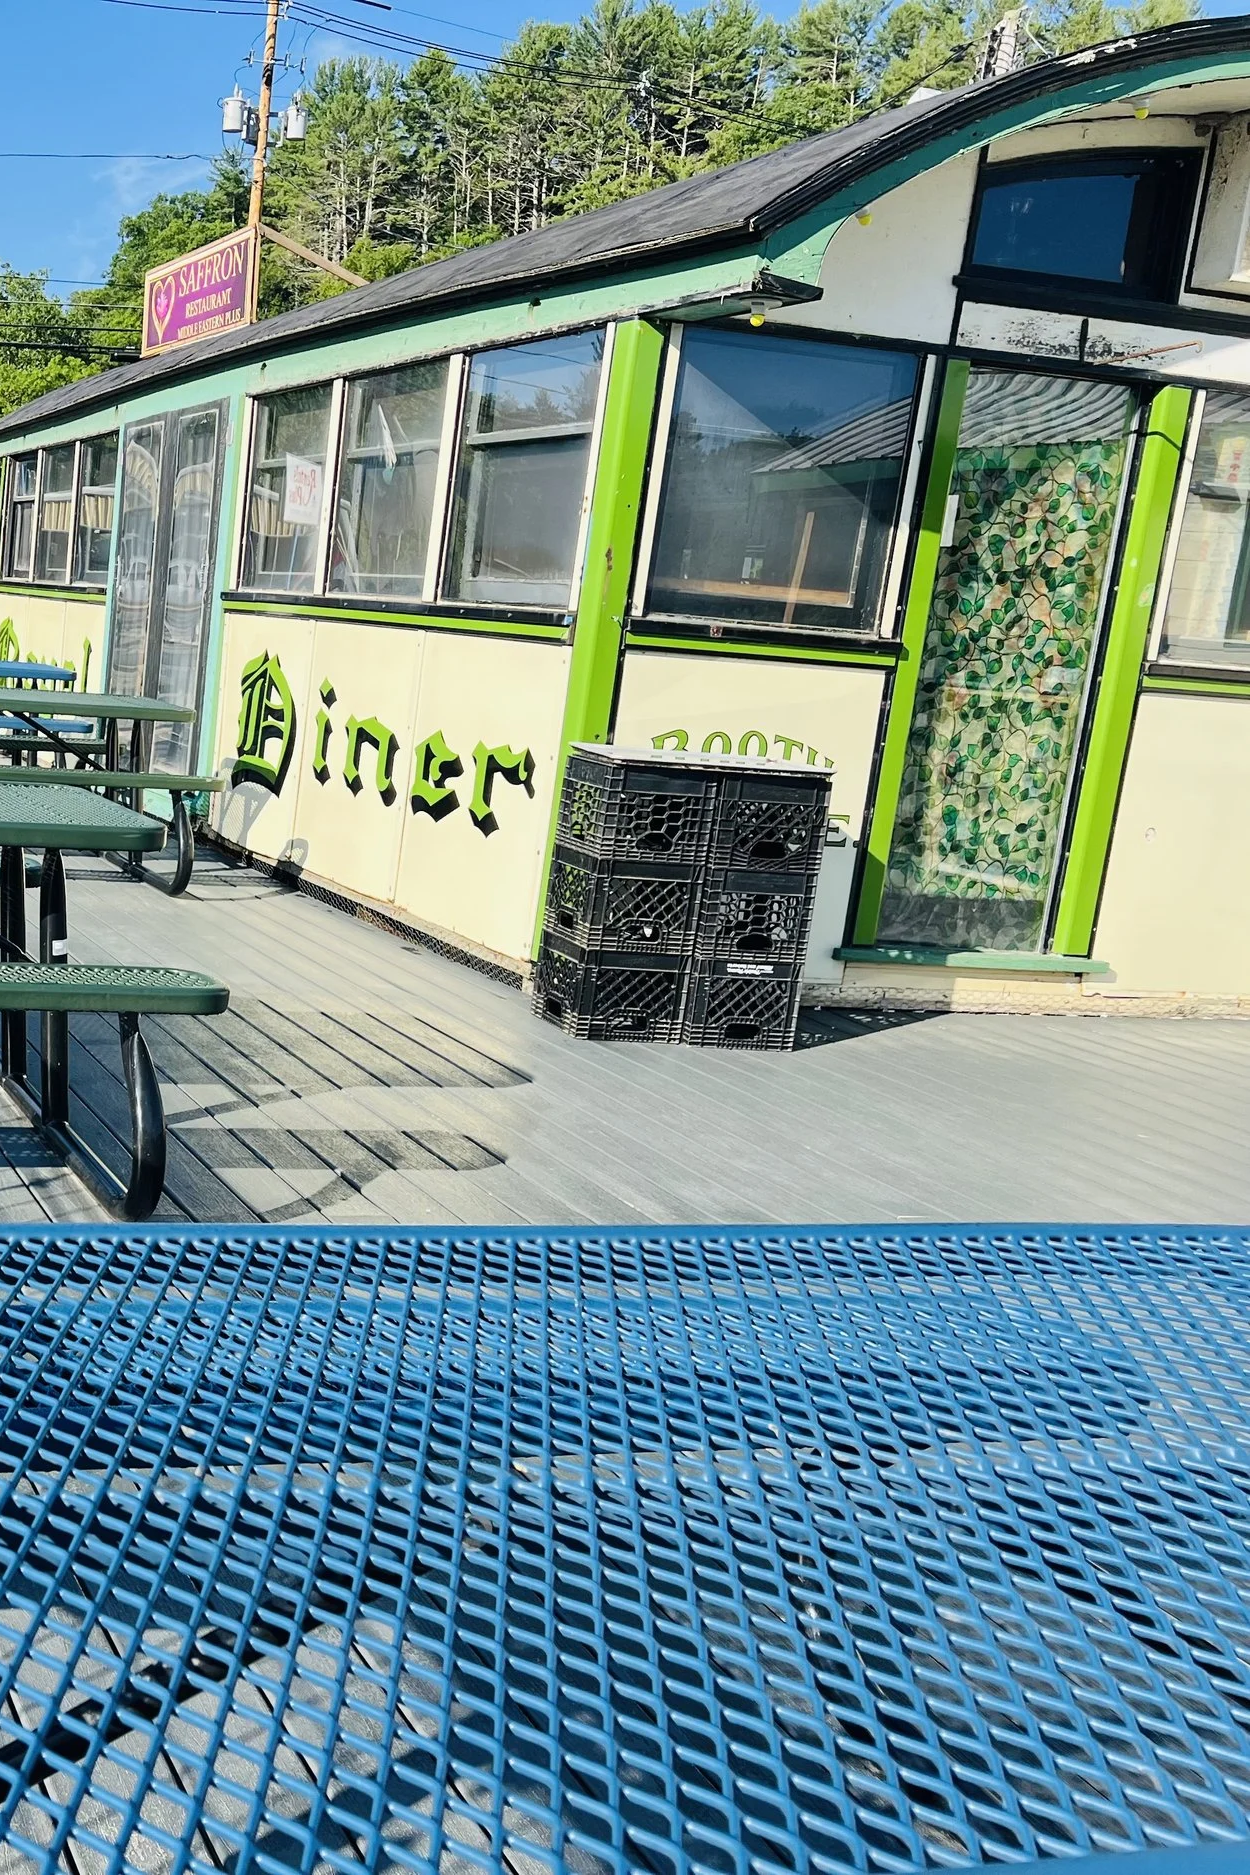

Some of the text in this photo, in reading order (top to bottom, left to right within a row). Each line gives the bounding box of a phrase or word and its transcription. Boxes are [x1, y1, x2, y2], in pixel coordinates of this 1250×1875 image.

[178, 242, 246, 297] SAFFRON
[178, 308, 241, 340] MIDDLE EASTERN PLUS
[185, 288, 232, 318] RESTAURANT
[231, 649, 536, 838] Diner
